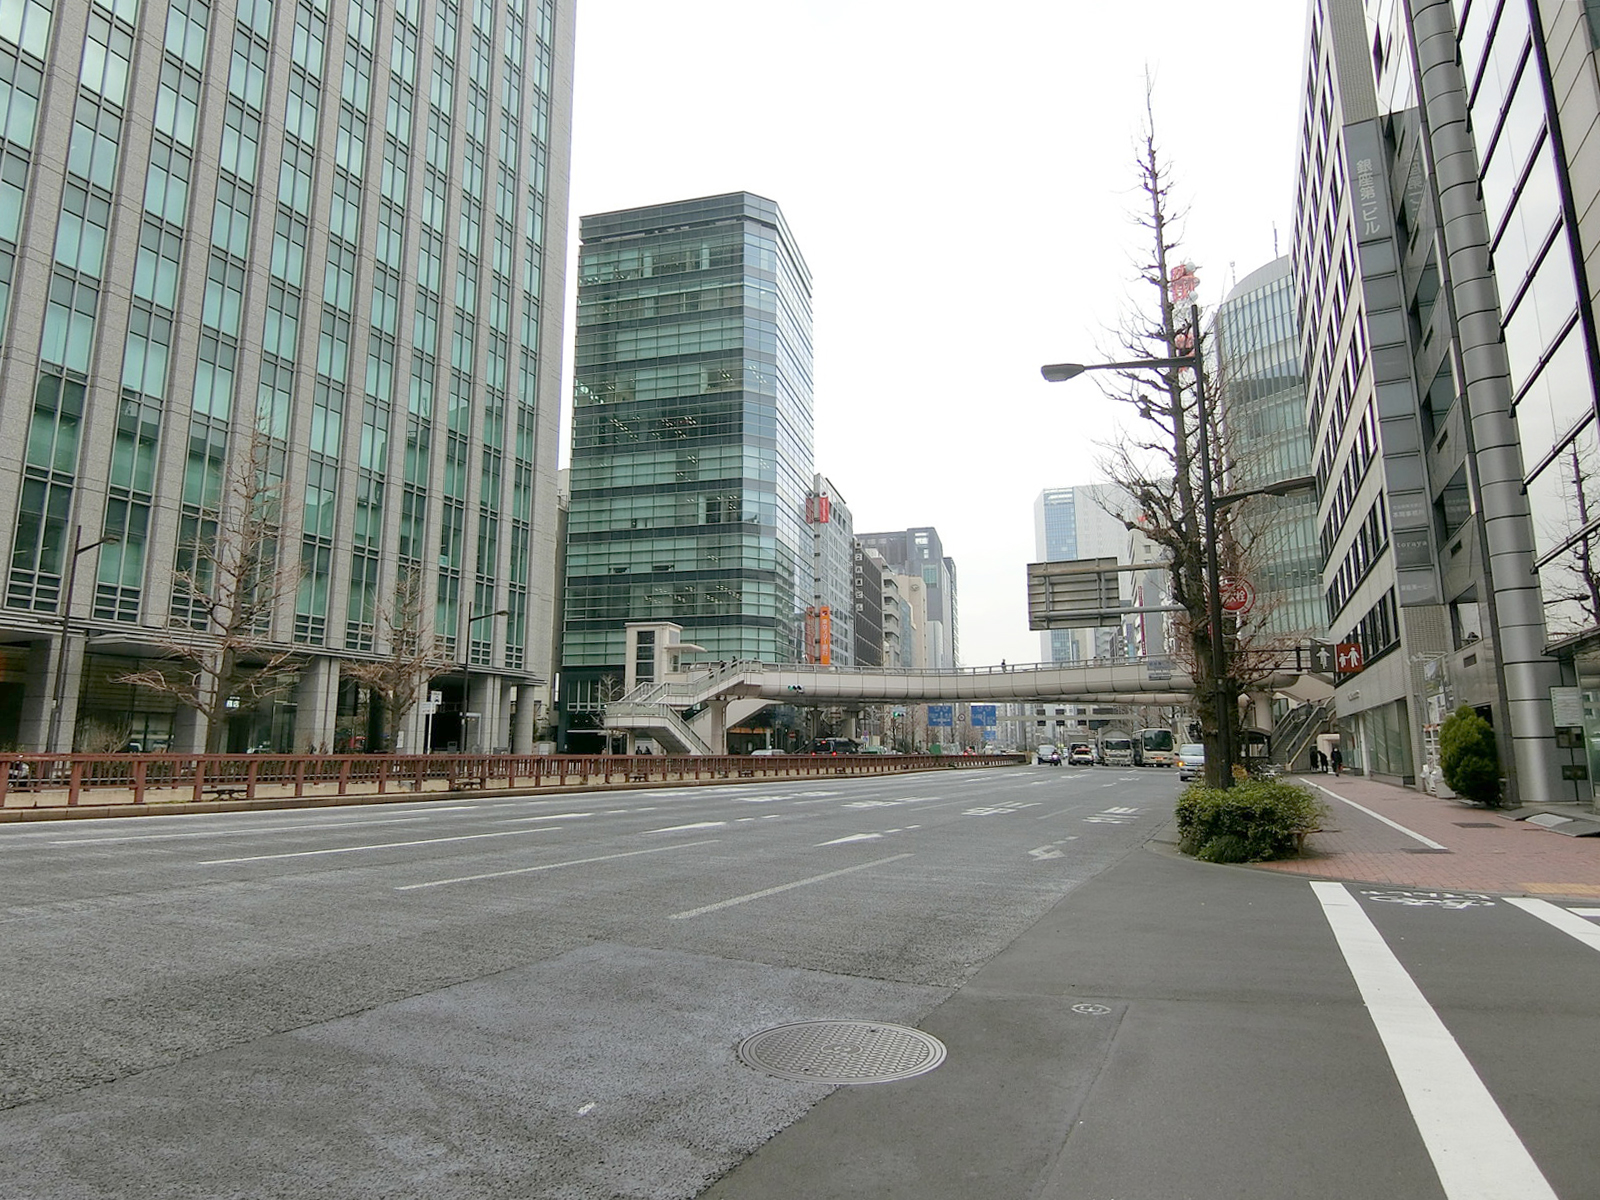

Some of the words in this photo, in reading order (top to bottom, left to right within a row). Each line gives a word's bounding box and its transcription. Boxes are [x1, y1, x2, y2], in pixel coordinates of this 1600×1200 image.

[1356, 158, 1381, 236] 銀座第一ビル
[1396, 540, 1428, 549] toraya
